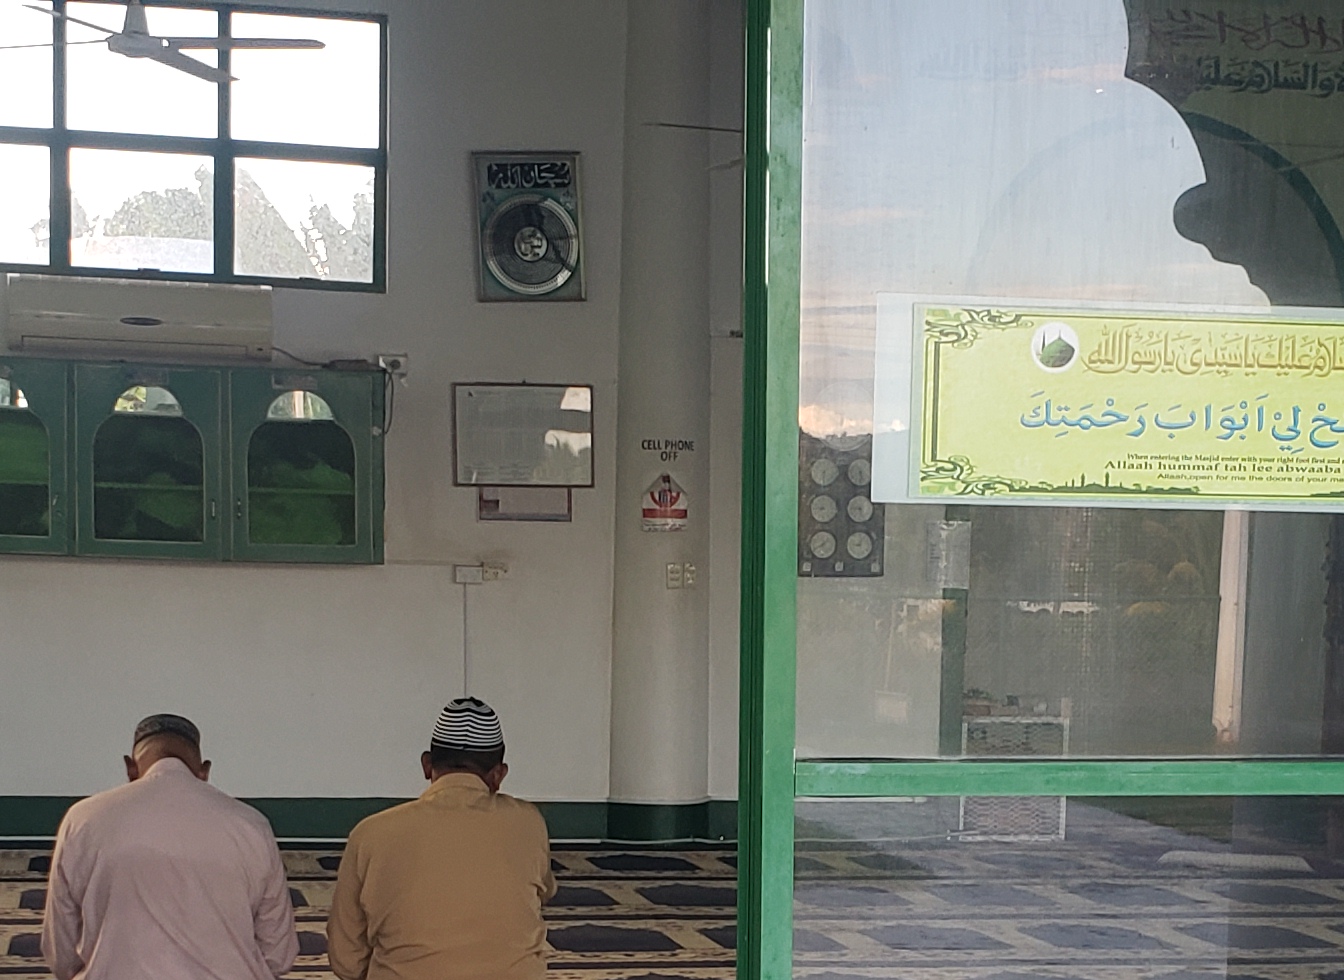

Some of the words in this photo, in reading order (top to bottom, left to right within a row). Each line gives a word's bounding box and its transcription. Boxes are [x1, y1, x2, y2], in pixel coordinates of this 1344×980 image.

[641, 439, 662, 450] CELL
[664, 440, 695, 451] PHONE
[660, 451, 679, 461] OFF
[1104, 460, 1153, 470] Allaah
[1158, 462, 1220, 471] hummaf
[1224, 462, 1247, 472] tah
[1252, 463, 1273, 472] lee
[1276, 464, 1341, 474] abwaaba
[1216, 473, 1228, 481] for
[1294, 474, 1305, 482] of
